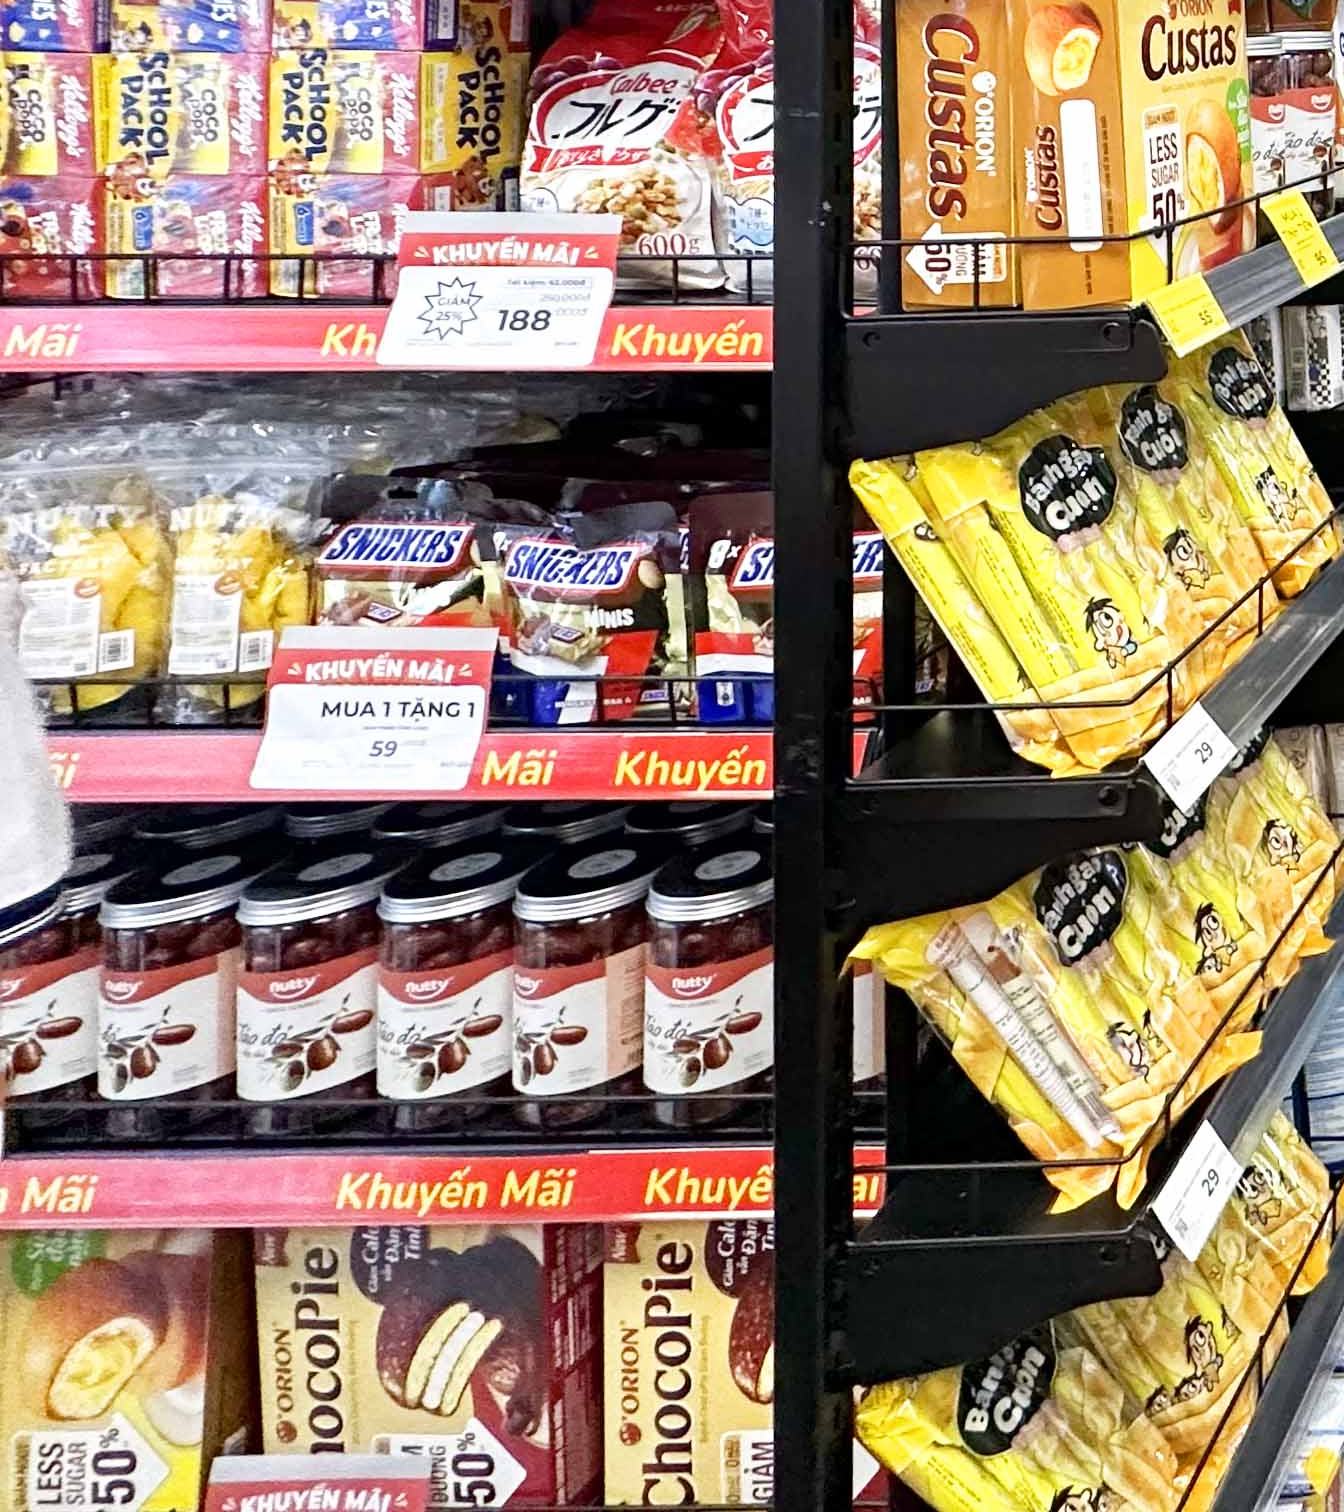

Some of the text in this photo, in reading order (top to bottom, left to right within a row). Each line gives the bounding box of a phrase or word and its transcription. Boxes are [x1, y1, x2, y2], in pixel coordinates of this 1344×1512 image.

[1141, 14, 1237, 82] Custas
[609, 70, 680, 95] Calbee
[119, 75, 144, 148] PACK
[281, 70, 304, 143] PACK
[475, 45, 502, 165] SCHOOL
[1149, 132, 1178, 167] LESS
[1151, 161, 1180, 188] SUGAR
[4, 323, 83, 357] Mãi
[498, 308, 552, 331] 188
[611, 320, 763, 362] Khuyến
[326, 524, 463, 565] SNICKERS
[506, 545, 633, 586] SNICKERS
[321, 698, 476, 723] MUA 1 TẶNG 1
[367, 740, 399, 758] 59
[481, 745, 767, 792] Mãi Khuyến
[1195, 742, 1214, 765] 29
[337, 1167, 577, 1216] Khuyến Mãi
[1202, 1168, 1221, 1196] 29
[643, 1240, 694, 1506] ChocoPie
[36, 1441, 65, 1506] LESS
[67, 1441, 86, 1506] SUGAR
